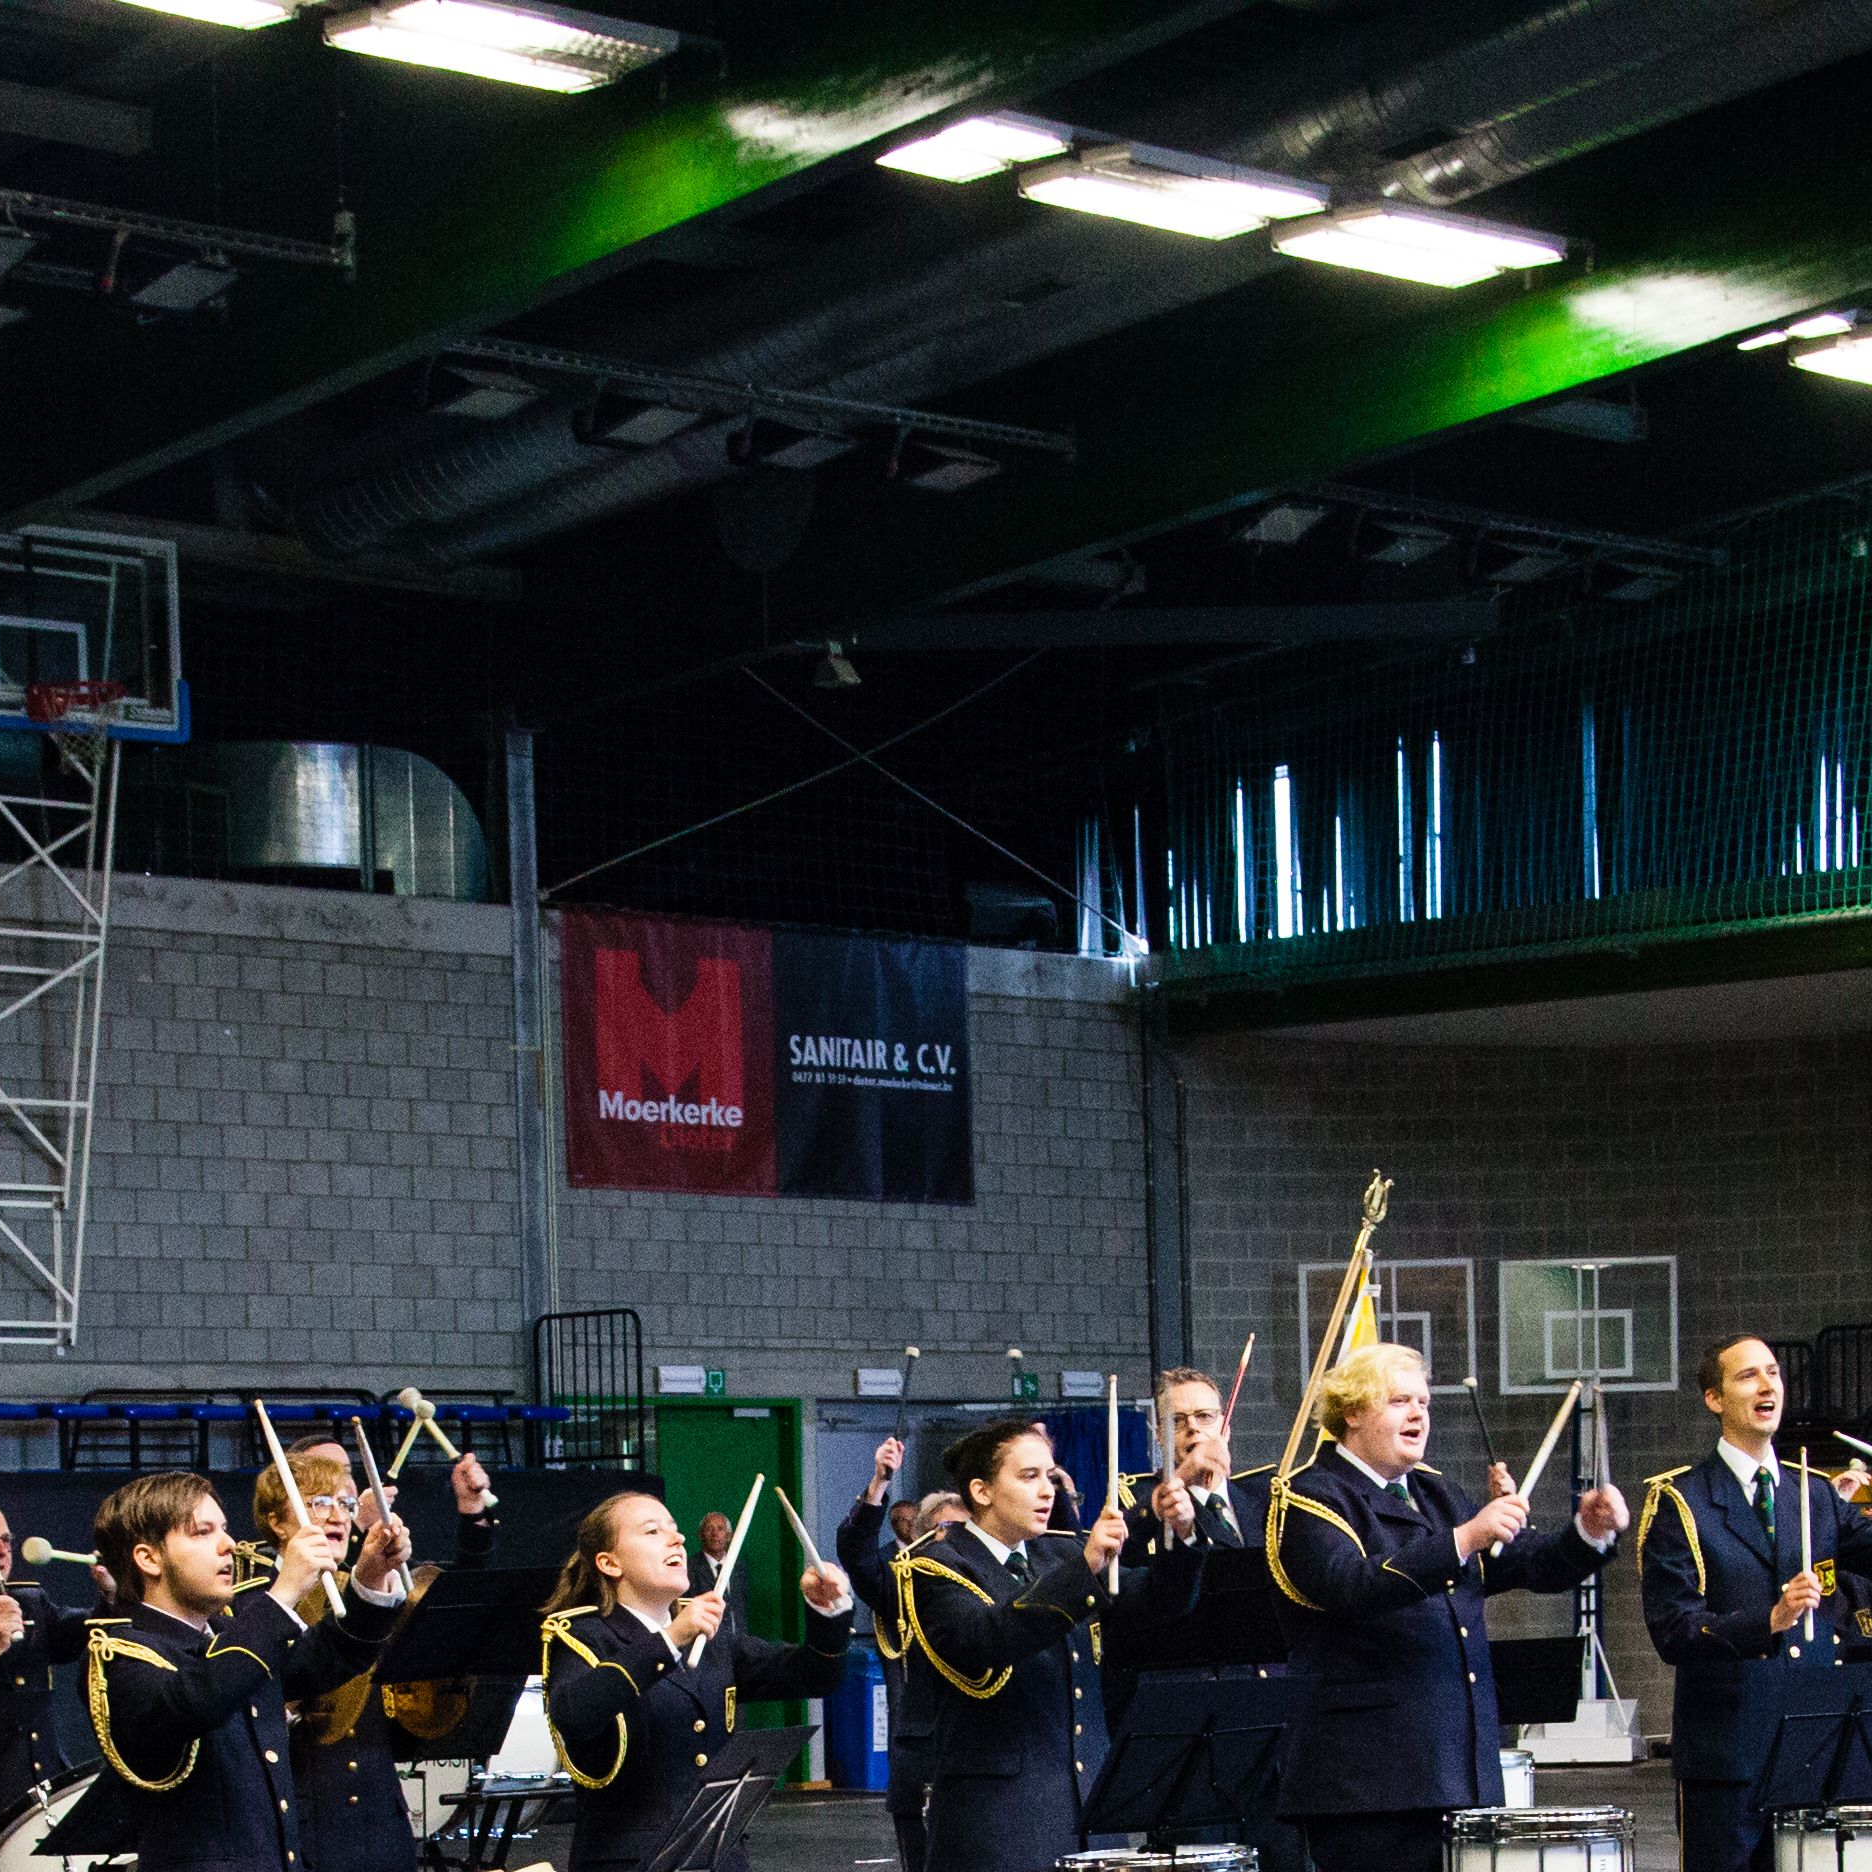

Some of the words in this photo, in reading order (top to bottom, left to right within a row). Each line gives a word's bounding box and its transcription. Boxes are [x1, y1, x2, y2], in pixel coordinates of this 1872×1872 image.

[789, 1034, 888, 1070] SANITAIR
[893, 1042, 909, 1072] &
[916, 1043, 957, 1075] C.V.
[598, 1088, 743, 1127] Moerkerke
